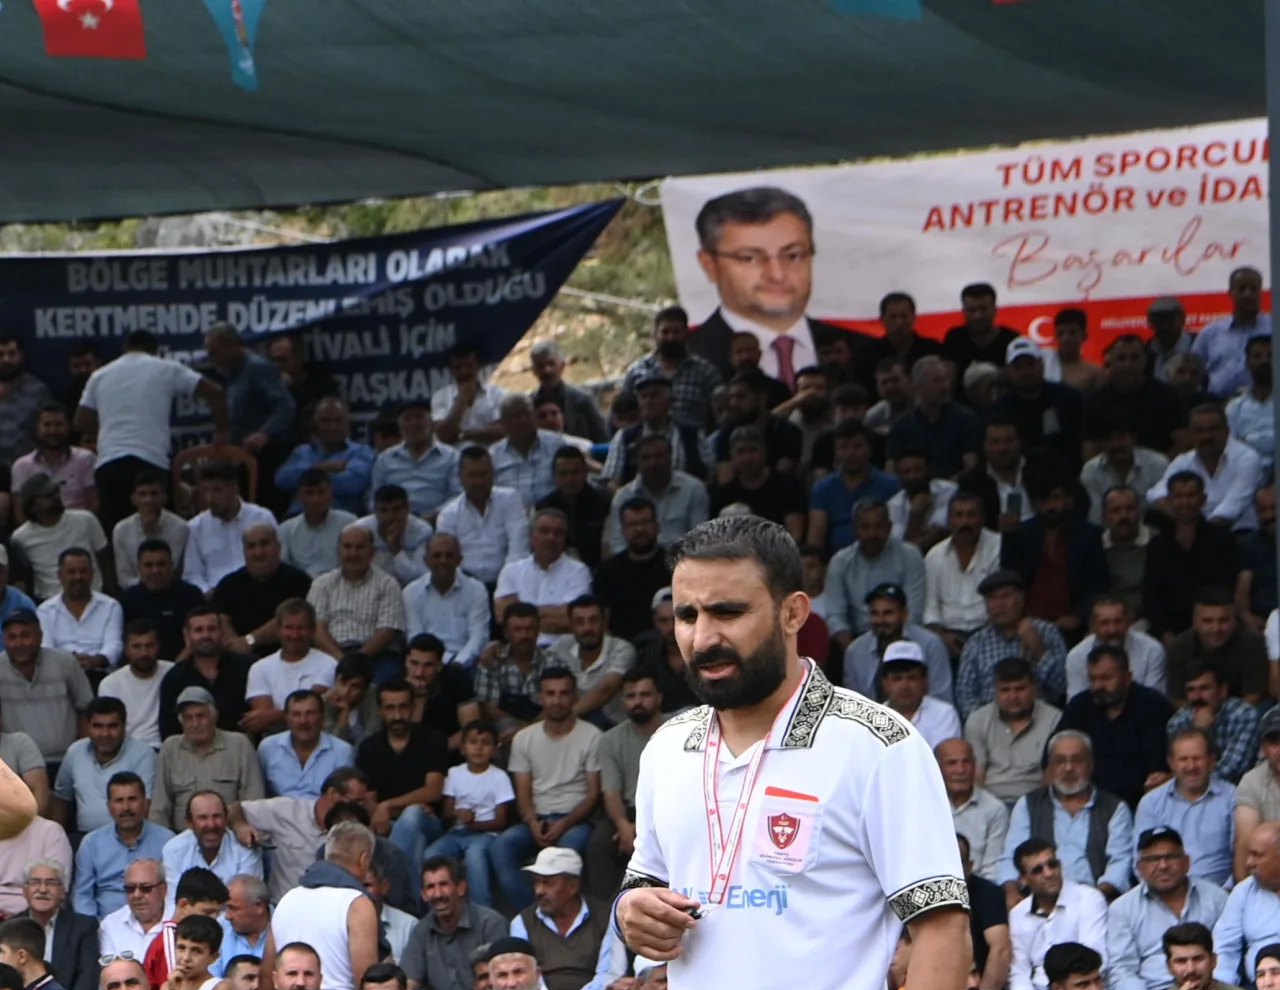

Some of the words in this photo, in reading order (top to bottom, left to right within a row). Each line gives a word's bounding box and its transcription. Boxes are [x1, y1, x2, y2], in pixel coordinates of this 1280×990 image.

[999, 157, 1082, 188] TÜM
[923, 183, 1135, 232] ANTRENÖR
[1147, 187, 1187, 208] ve
[1199, 172, 1269, 204] İDA
[69, 256, 168, 292] BÖLGE
[178, 251, 375, 290] MUHTARLARI
[34, 301, 218, 338] KERTMENDE
[424, 267, 546, 312] OLDUĞU
[726, 884, 788, 916] Enerji
